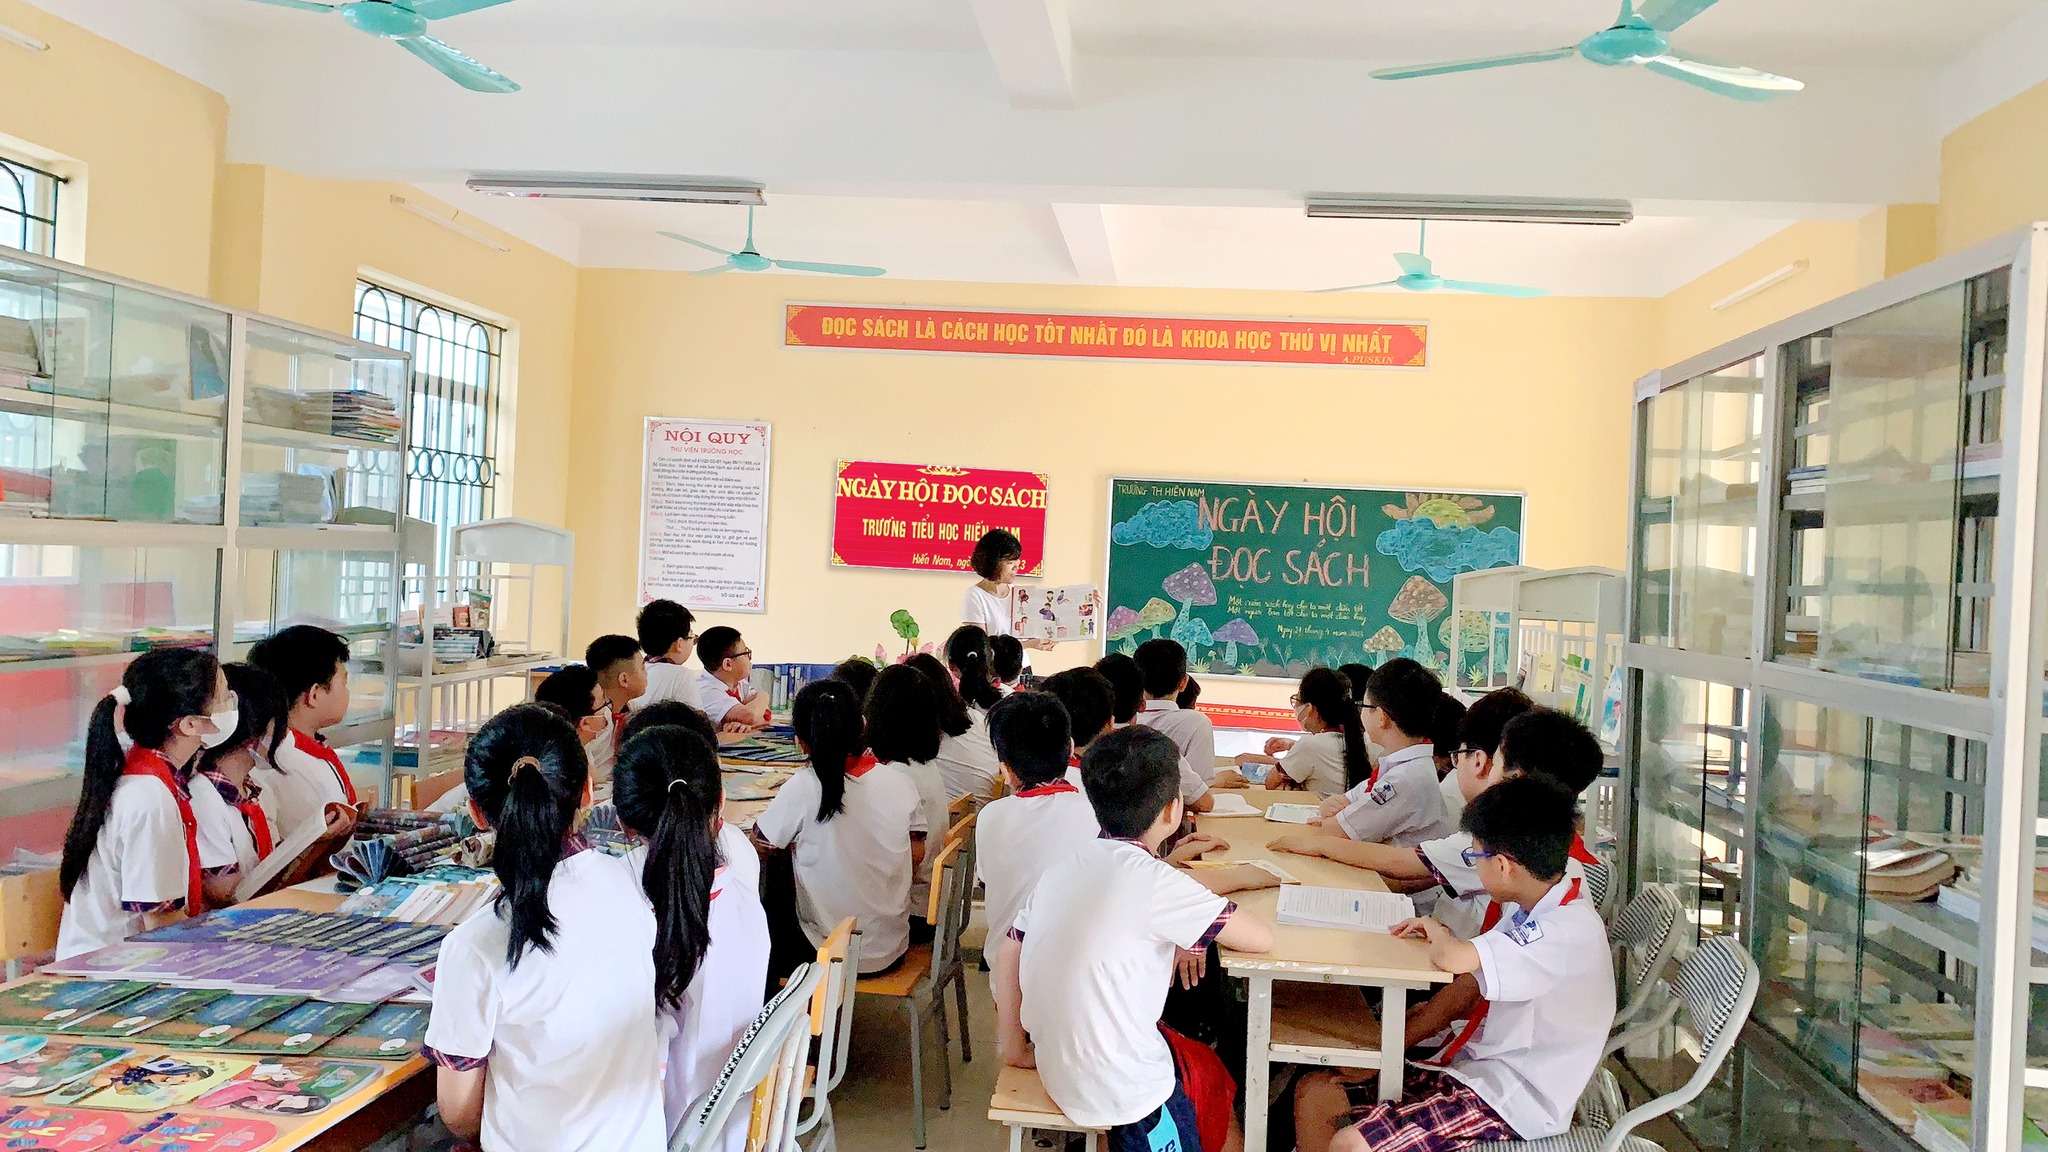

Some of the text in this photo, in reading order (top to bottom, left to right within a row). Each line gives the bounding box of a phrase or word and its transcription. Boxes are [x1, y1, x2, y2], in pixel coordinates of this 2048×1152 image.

[822, 315, 1393, 356] ĐỌC SÁCH LÀ CÁCH HỌC TỐT NHẤT ĐÓ LÀ KHOA HỌC THÚ VỊ NHẤT
[664, 427, 751, 445] NỘI QUY
[671, 446, 682, 454] THƯ
[684, 446, 700, 455] VIỆN
[728, 448, 744, 457] HỌC
[836, 472, 1048, 510] NGÀY HỘI ĐỌC SÁCH
[1151, 485, 1163, 496] TH
[1186, 487, 1205, 498] NAM
[862, 515, 907, 538] TRƯỜNG
[911, 513, 935, 540] TIỂU
[938, 522, 959, 545] HỌC
[1197, 488, 1358, 542] NGÀY HỘI
[1206, 538, 1370, 589] ĐỌC SÁCH
